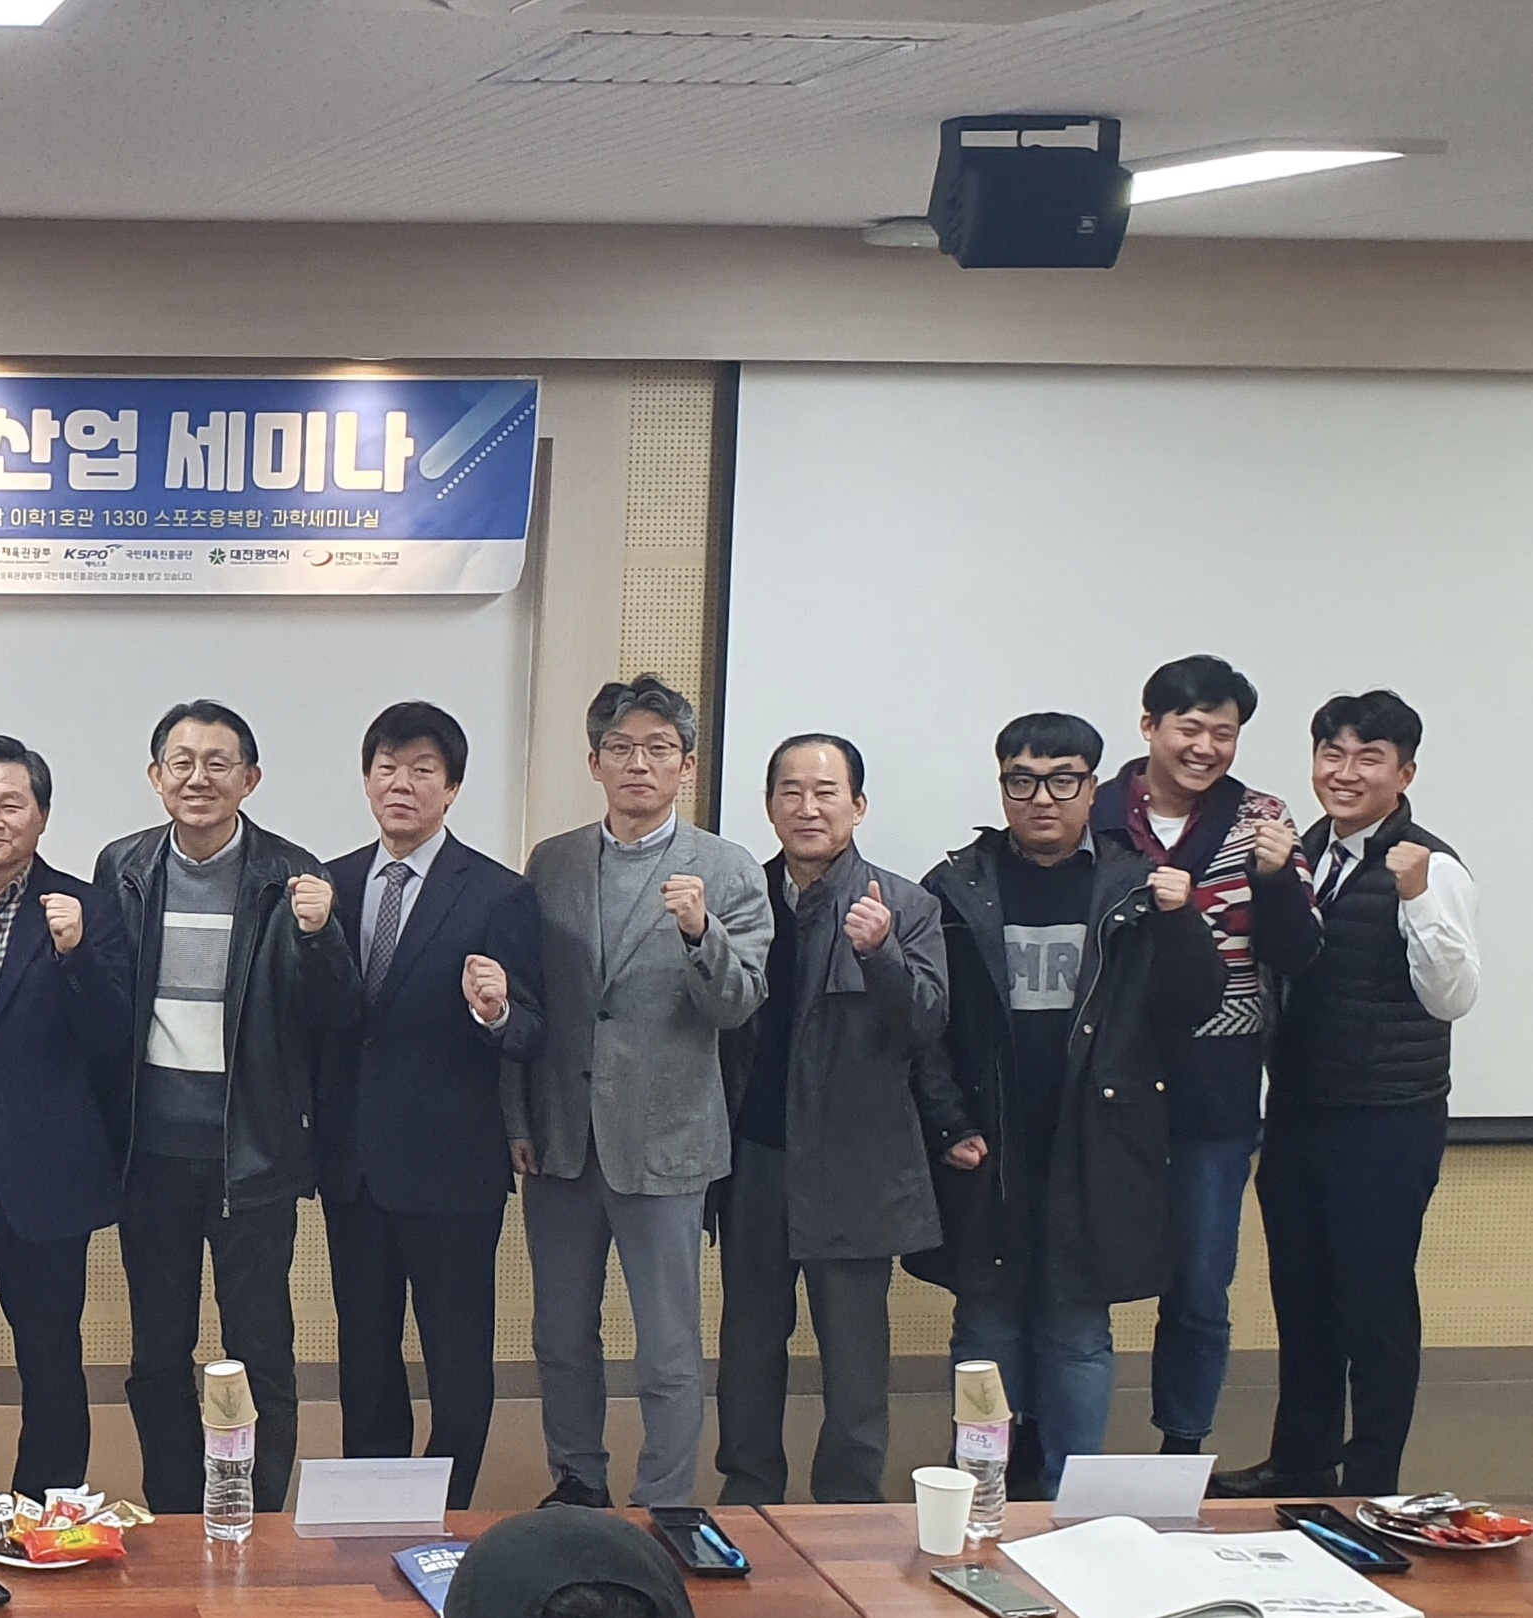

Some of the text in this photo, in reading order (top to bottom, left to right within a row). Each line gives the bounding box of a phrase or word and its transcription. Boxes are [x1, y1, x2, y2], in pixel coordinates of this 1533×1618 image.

[164, 410, 415, 493] 세미나
[10, 508, 95, 528] 이학1호관
[102, 509, 147, 527] 1330
[64, 548, 109, 560] KSPO
[126, 549, 193, 560] 국민체육진흥공단
[230, 549, 290, 561] 대전광역시
